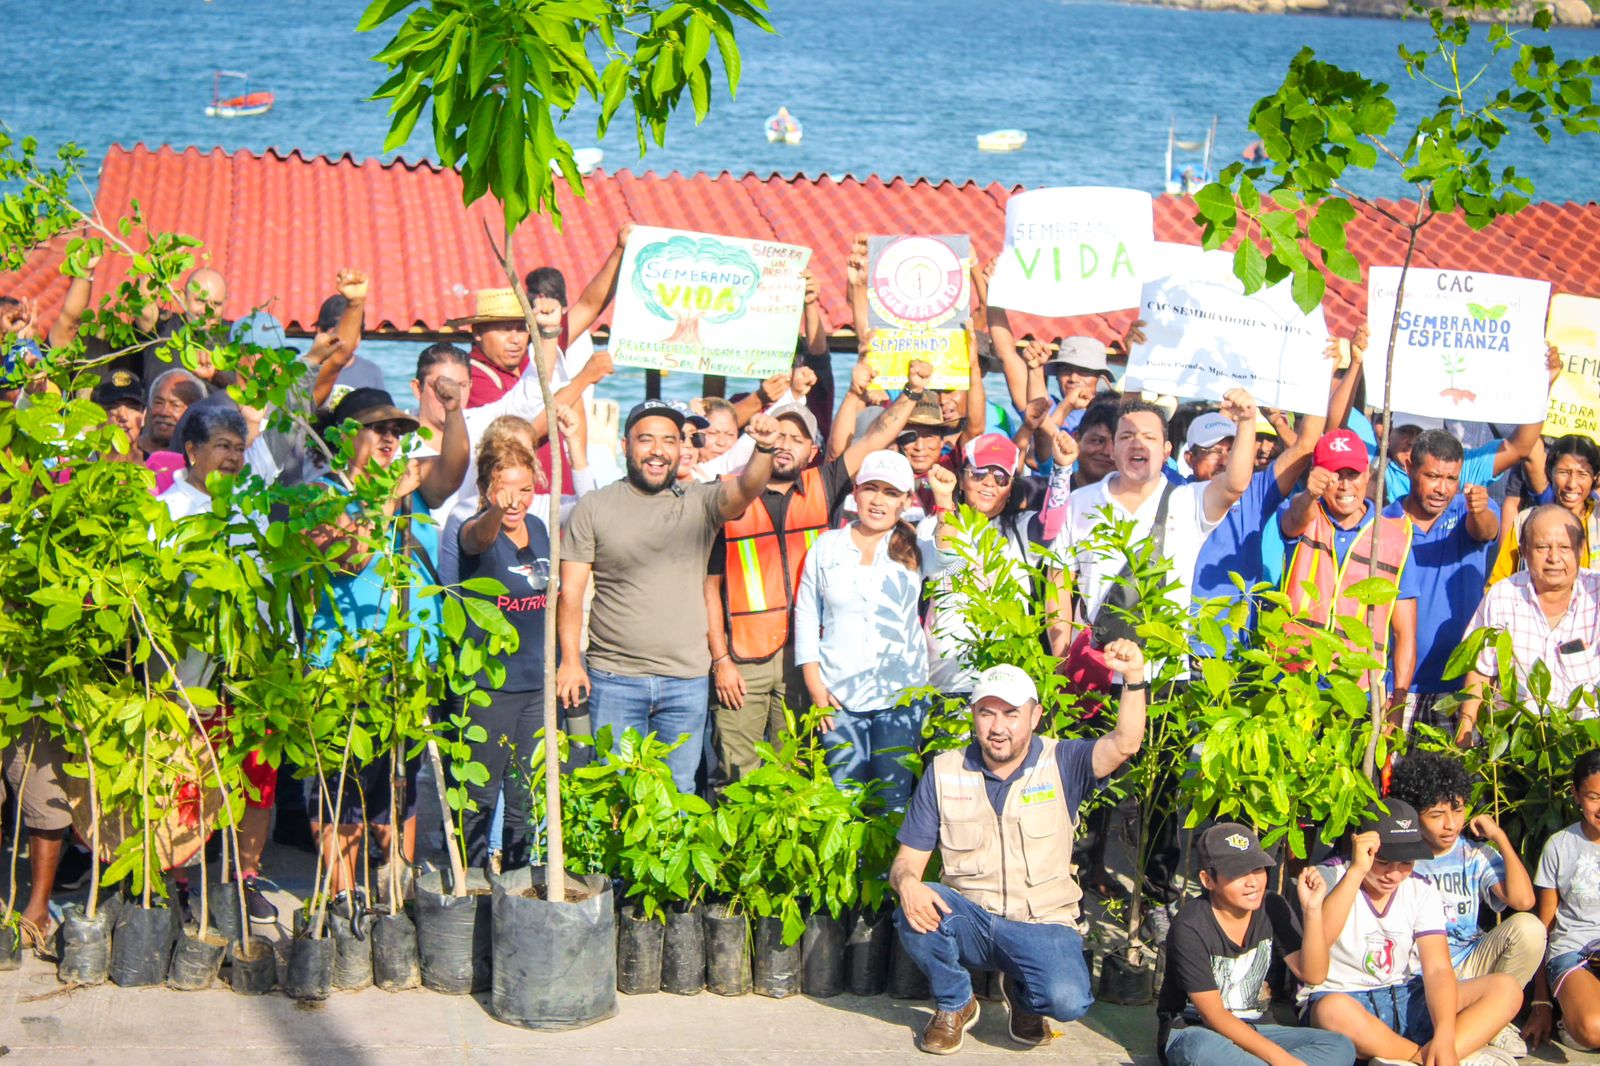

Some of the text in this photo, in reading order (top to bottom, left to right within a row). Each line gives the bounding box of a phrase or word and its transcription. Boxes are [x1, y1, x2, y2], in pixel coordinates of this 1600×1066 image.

[752, 243, 803, 262] SIEMBRA
[1014, 241, 1136, 283] VIDA
[1437, 272, 1475, 293] CAC
[655, 283, 736, 313] VIDA
[1398, 310, 1512, 336] SEMBRANDO
[871, 337, 949, 352] SEMBRANDO
[1407, 328, 1511, 353] ESPERANZA
[1548, 399, 1595, 419] IEDRA
[1573, 417, 1598, 433] SAN
[1433, 871, 1471, 897] YORK
[1457, 900, 1472, 915] 87
